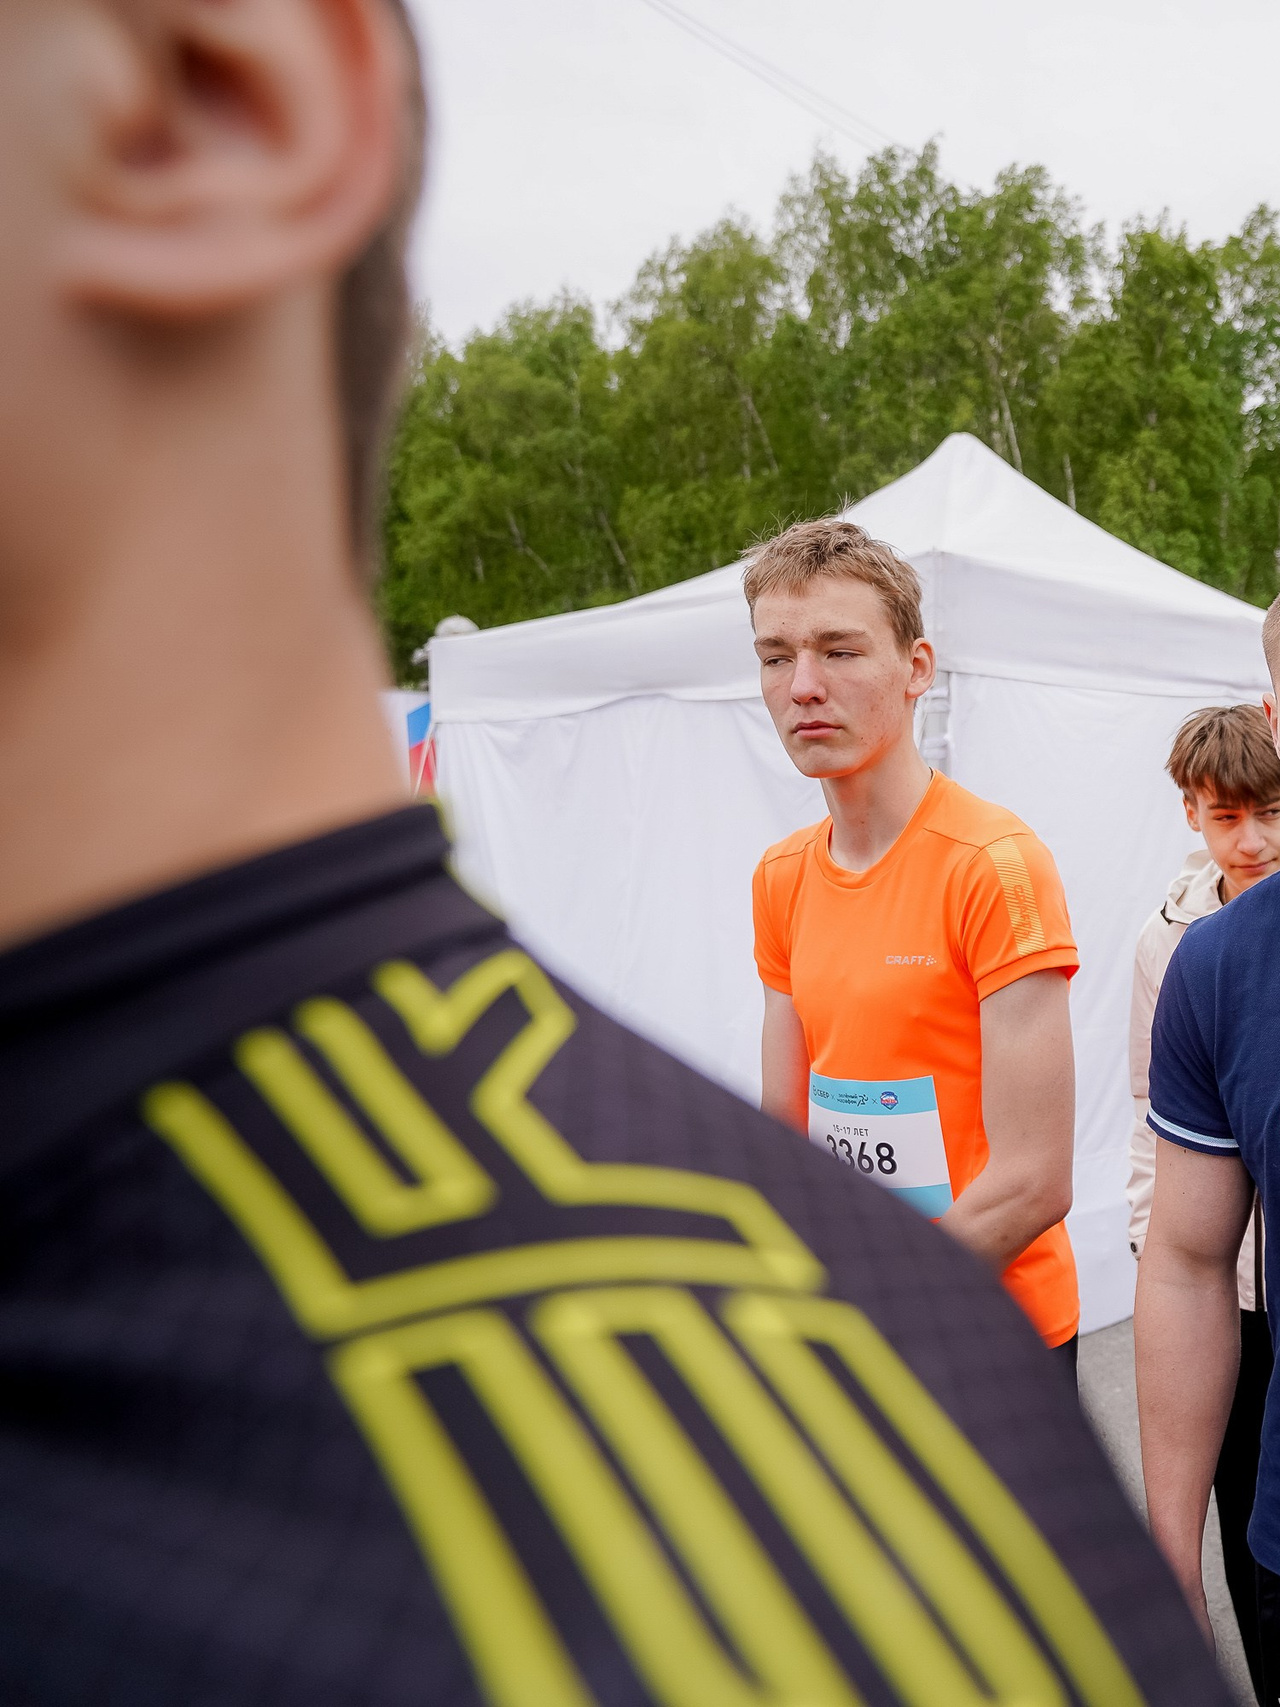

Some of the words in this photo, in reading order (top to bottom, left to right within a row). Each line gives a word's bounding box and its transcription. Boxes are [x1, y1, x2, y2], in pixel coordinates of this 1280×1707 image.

[885, 955, 925, 966] CRAFT
[833, 1124, 851, 1135] 15-17
[853, 1128, 869, 1137] ЛЕТ
[826, 1134, 898, 1175] 3368
